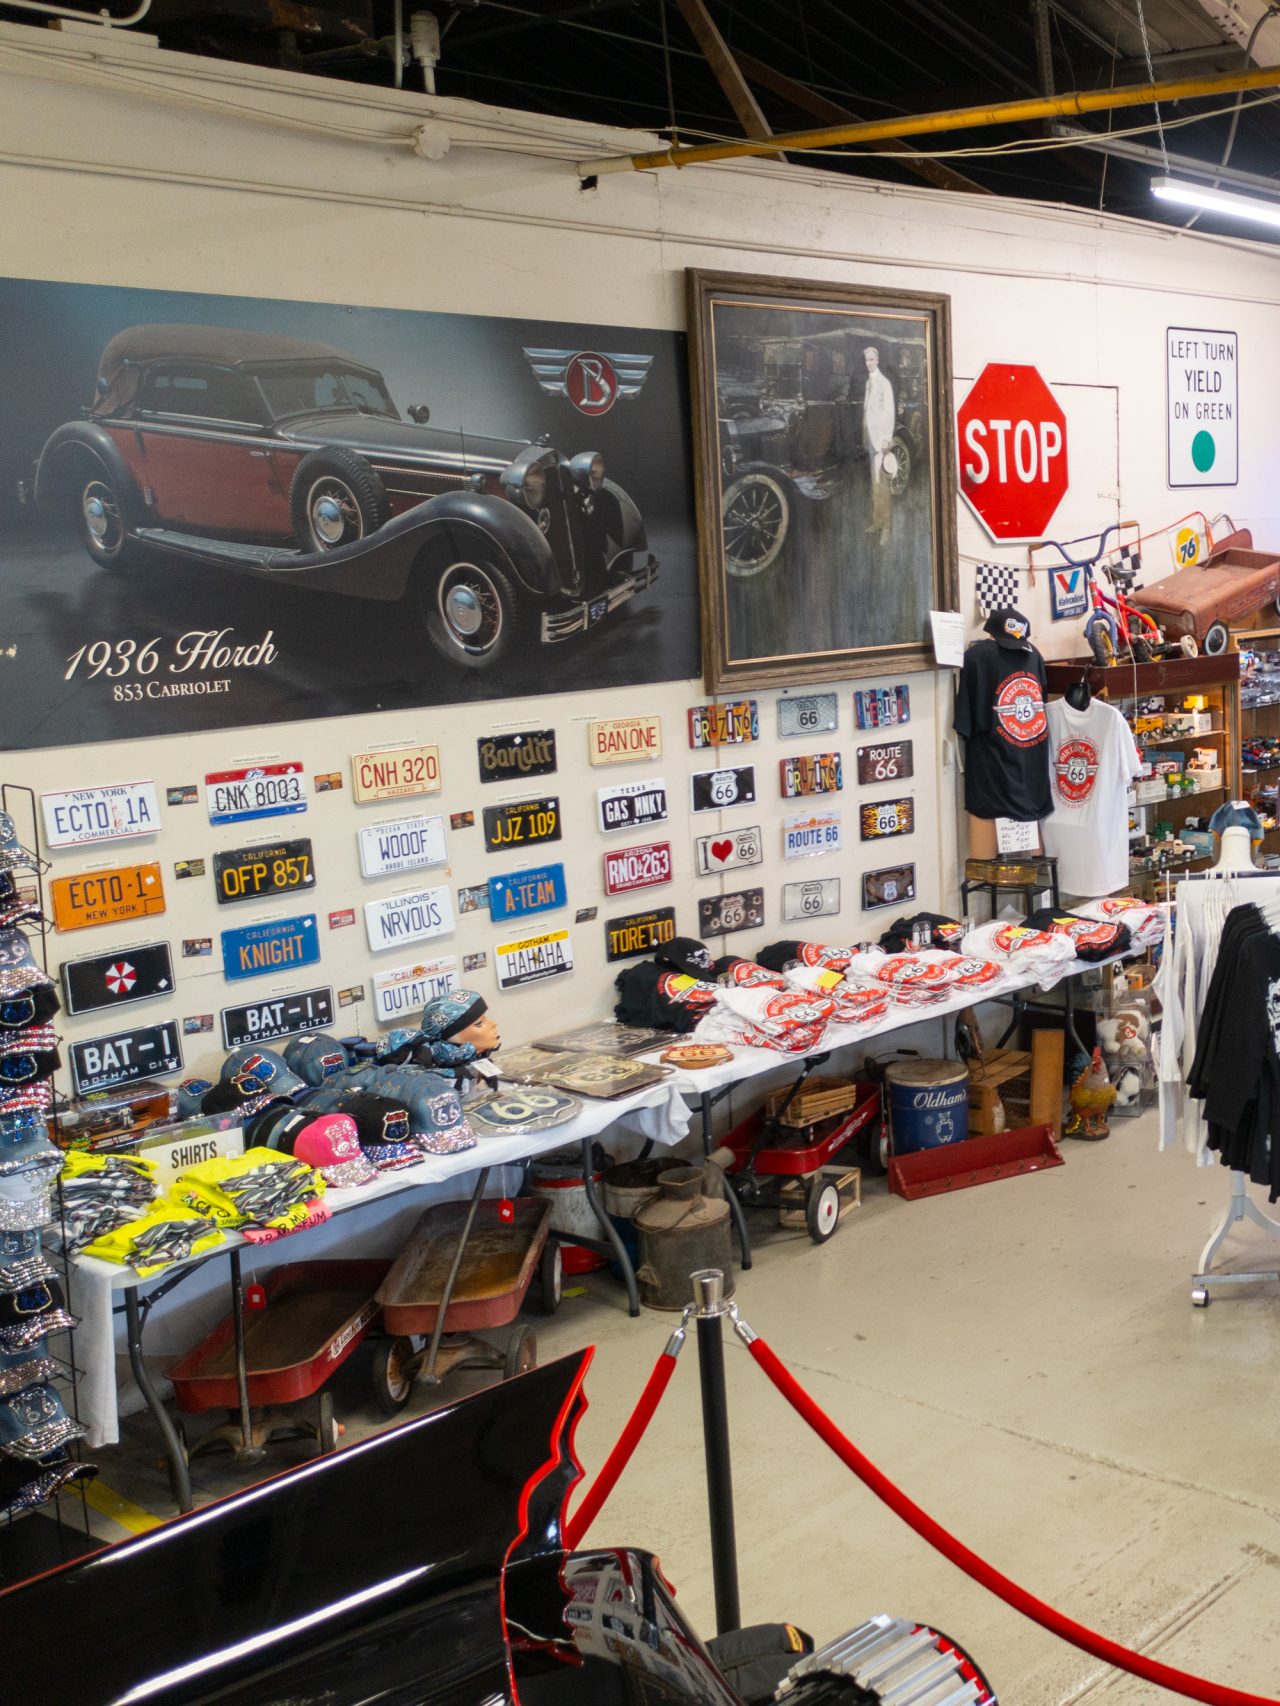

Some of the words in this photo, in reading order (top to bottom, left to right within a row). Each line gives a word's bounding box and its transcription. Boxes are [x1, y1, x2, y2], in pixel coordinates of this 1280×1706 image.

[1170, 339, 1199, 359] LEFT
[1204, 341, 1234, 361] TURN
[1184, 369, 1222, 393] YIELD
[1174, 402, 1190, 419] ON
[1196, 402, 1233, 420] GREEN
[965, 418, 1062, 485] STOP
[1180, 538, 1196, 564] 76
[1058, 594, 1084, 607] Valvoline
[64, 635, 161, 682] 1936
[170, 628, 279, 675] Horch
[113, 683, 145, 702] 853
[799, 710, 818, 726] 66
[1017, 705, 1031, 719] 66
[612, 720, 641, 729] GEORGIA
[693, 707, 743, 743] CRUZIN
[743, 708, 759, 738] 66
[597, 729, 628, 753] BAN
[630, 726, 657, 749] ONE
[481, 738, 553, 771] Bandit
[869, 746, 902, 762] ROUTE
[361, 761, 398, 789] CNH
[402, 755, 437, 784] 320
[715, 774, 734, 782] ROUTE
[786, 762, 829, 793] CRUZIN
[829, 761, 843, 787] 66
[875, 759, 898, 780] 66
[1070, 768, 1085, 781] 66
[72, 793, 95, 802] NEW
[100, 787, 128, 797] YORK
[215, 784, 250, 812] CNK
[386, 786, 417, 796] HAZZARD
[620, 784, 647, 795] TEXAS
[715, 785, 734, 801] 66
[54, 801, 109, 834] ECTO
[127, 796, 151, 824] 1A
[505, 803, 540, 815] CALIFORNIA
[605, 799, 628, 823] GAS
[634, 793, 664, 818] MNKY
[491, 817, 524, 844] JJZ
[528, 811, 557, 838] 109
[879, 815, 897, 831] 66
[78, 826, 134, 841] COMMERCIAL
[788, 830, 822, 849] ROUTE
[825, 825, 839, 842] 66
[243, 848, 287, 861] CALIFORNIA
[623, 847, 653, 858] ARIZONA
[702, 841, 711, 871] I
[739, 835, 754, 843] ROUTE
[739, 842, 755, 857] 66
[385, 861, 405, 871] RHODE
[407, 857, 429, 867] ISLAND
[608, 857, 638, 885] RNO
[642, 851, 669, 877] 263
[223, 862, 267, 896] OFP
[273, 855, 310, 888] 857
[508, 872, 548, 885] CALIFORNIA
[69, 871, 147, 909] ECTO-1
[505, 879, 556, 913] A-TEAM
[385, 892, 430, 911] ILLINOIS
[804, 895, 820, 910] 66
[86, 909, 107, 921] NEW
[113, 904, 138, 916] YORK
[380, 902, 442, 939] NRVOUS
[625, 914, 658, 926] CALIFORNIA
[723, 908, 742, 924] 66
[246, 925, 296, 941] CALIFORNIA
[518, 935, 549, 950] GOTHAM
[610, 919, 675, 955] TORETTO
[918, 932, 929, 945] XL
[239, 935, 304, 971] KNIGHT
[506, 941, 565, 977] HAHAHA
[962, 961, 984, 974] 66
[383, 974, 454, 1013] OUTATIME
[233, 1024, 290, 1045] GOTHAM
[299, 1016, 330, 1029] CITY
[680, 1050, 717, 1058] 66
[80, 1066, 139, 1087] GOTHAM
[490, 1092, 559, 1120] 66
[913, 1089, 967, 1109] Oldham's
[171, 1140, 218, 1169] SHIRTS
